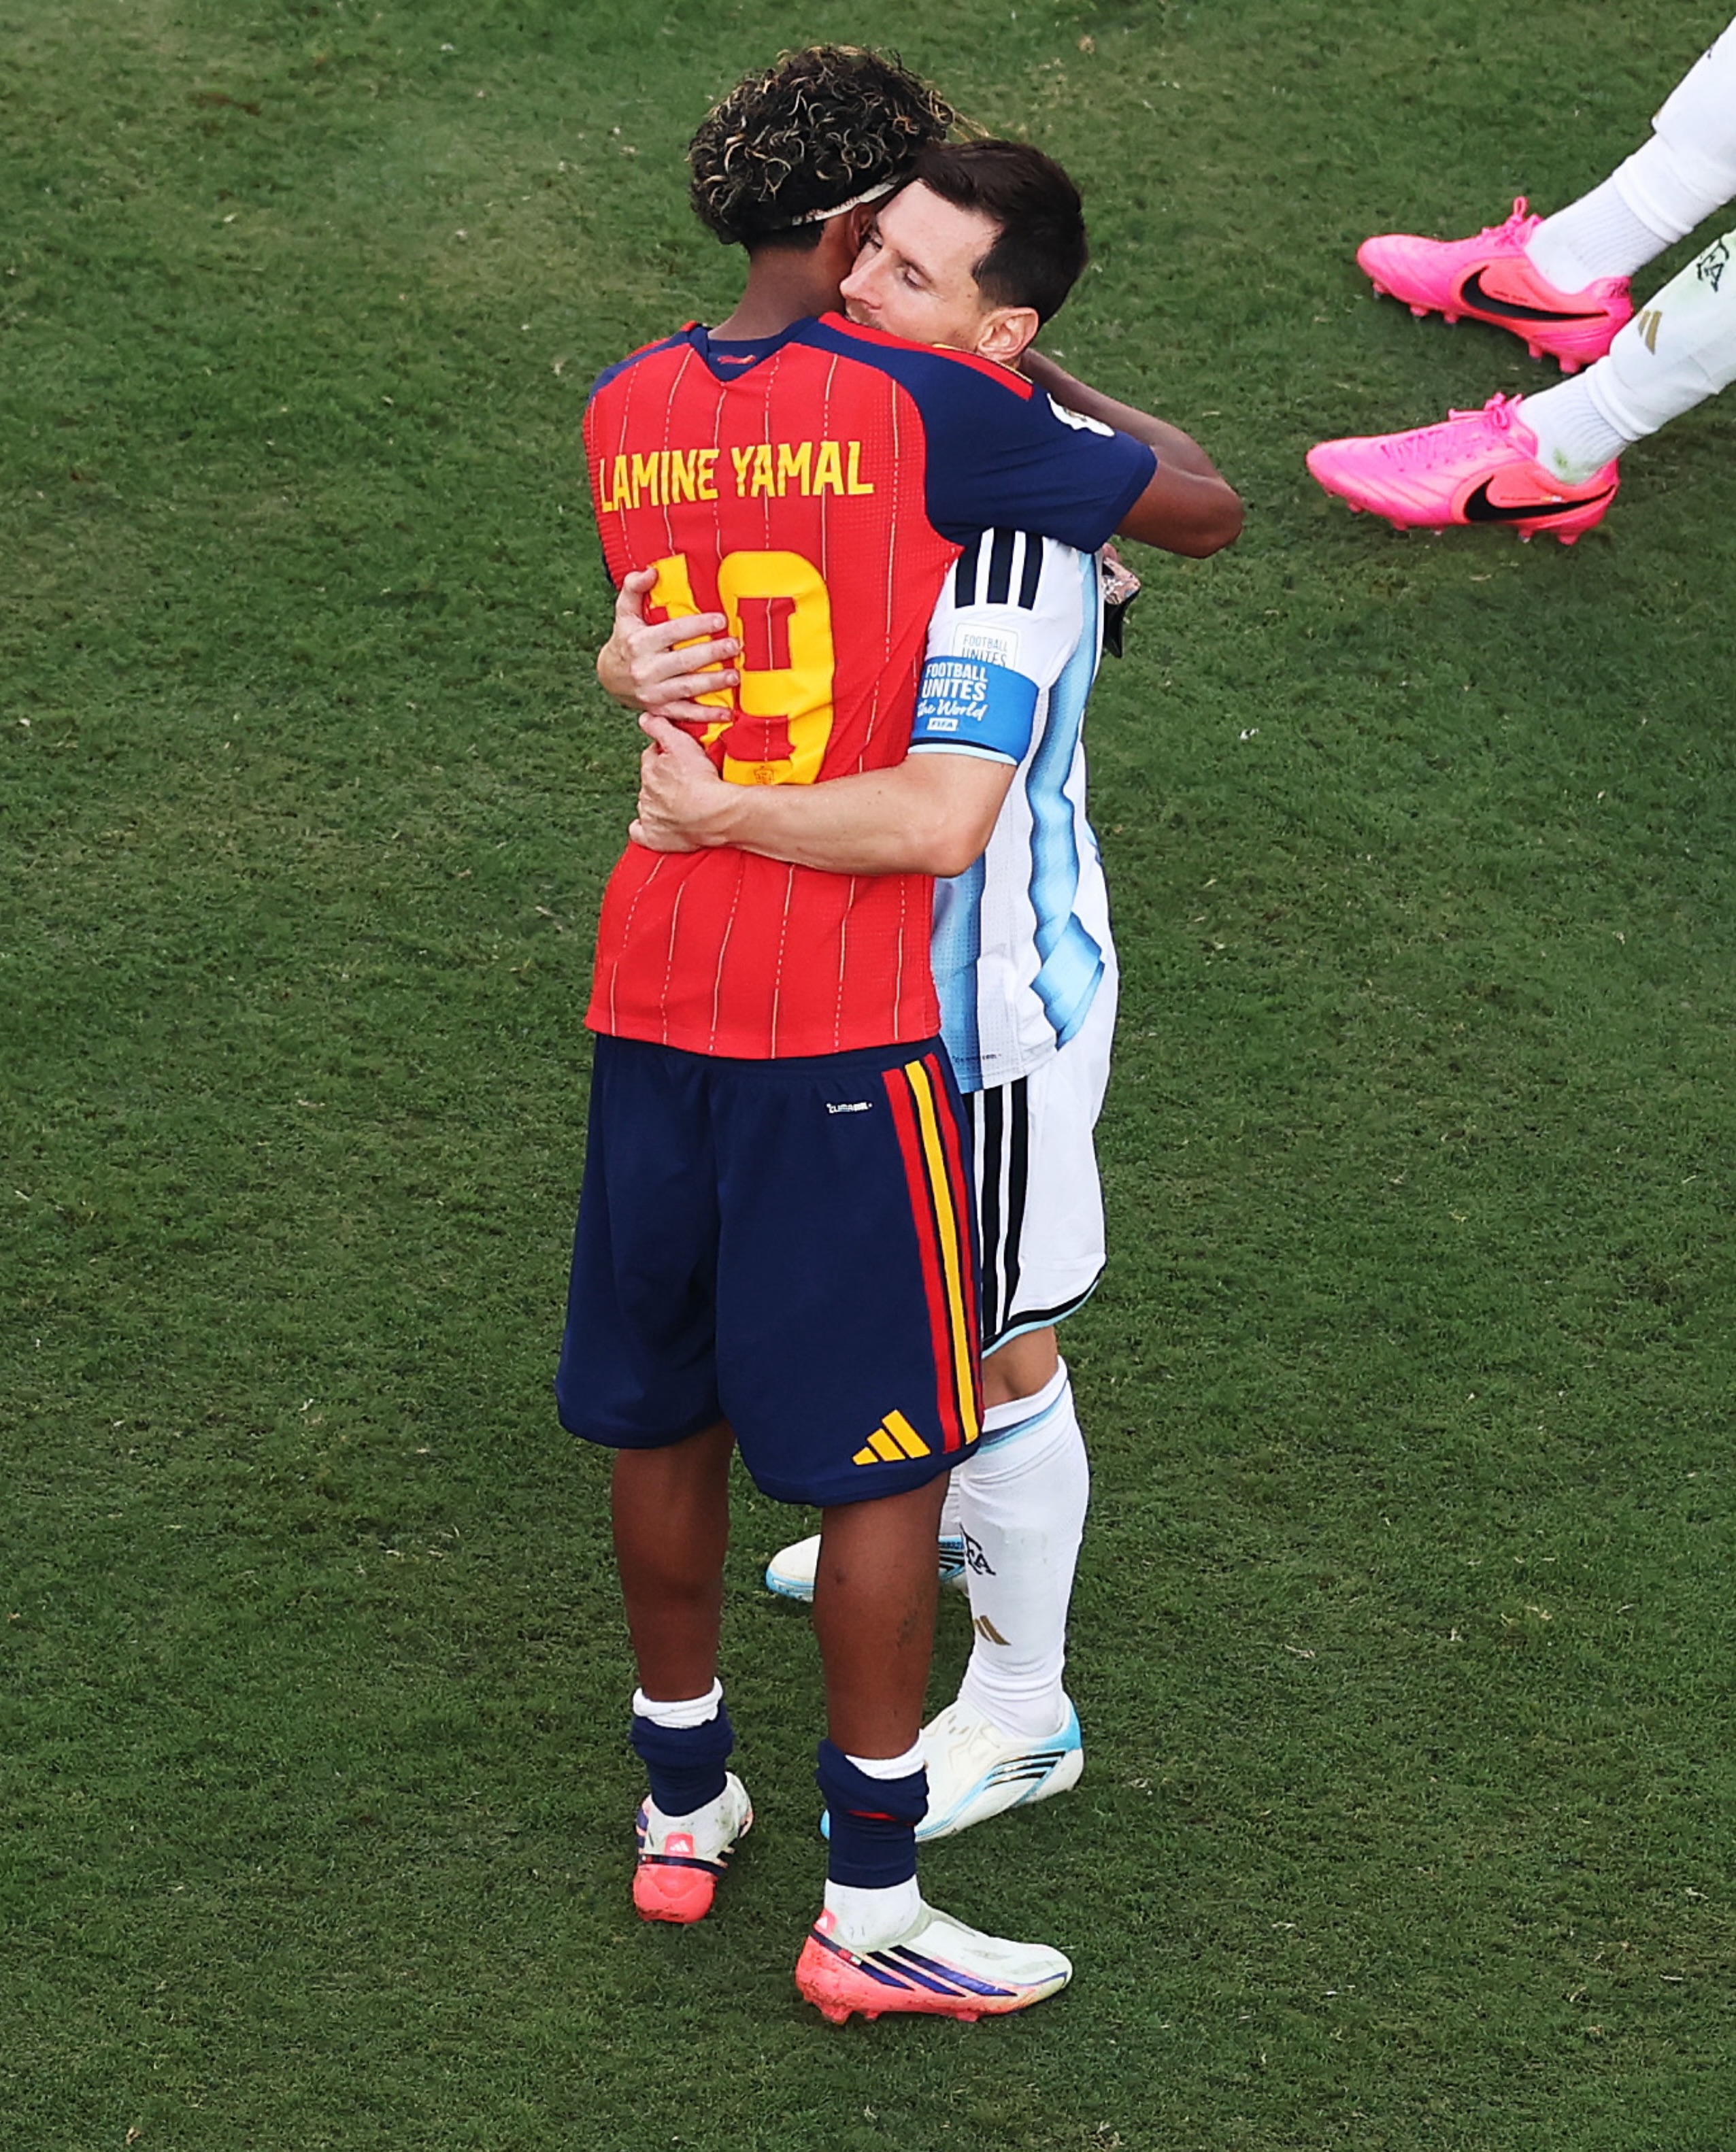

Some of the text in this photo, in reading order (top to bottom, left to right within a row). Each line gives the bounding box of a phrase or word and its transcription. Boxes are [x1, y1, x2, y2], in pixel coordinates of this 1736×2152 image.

[601, 441, 874, 513] LAMINE YAMAL
[963, 634, 1007, 652] FOOTBALL
[961, 647, 1007, 668] UNITES
[925, 661, 988, 682] FOOTBALL
[921, 678, 987, 701] UNITES
[917, 699, 988, 722] the World
[931, 720, 954, 728] FIFA
